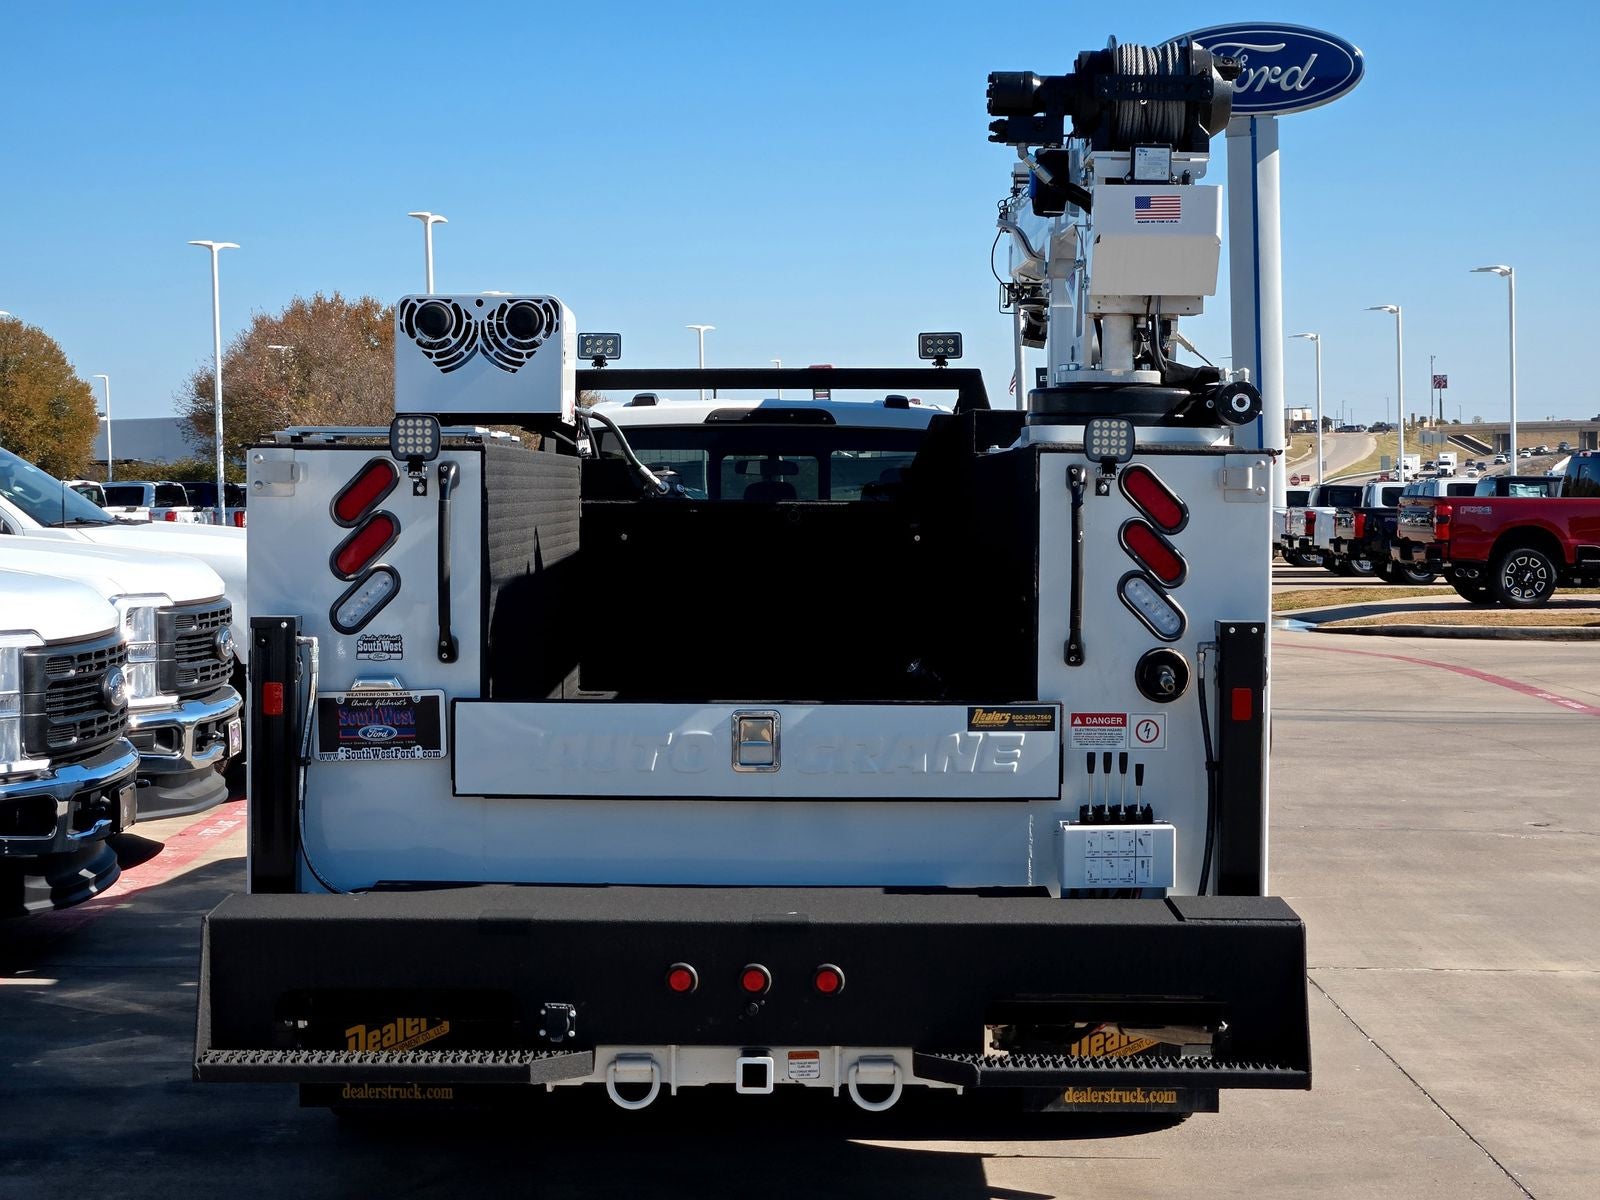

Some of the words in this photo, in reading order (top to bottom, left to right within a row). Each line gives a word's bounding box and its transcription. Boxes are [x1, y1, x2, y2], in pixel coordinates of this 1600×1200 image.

[338, 707, 416, 726] SouthWest
[971, 708, 1011, 724] Dealers
[1085, 716, 1123, 725] DANGER
[366, 727, 389, 738] Ford
[796, 731, 1026, 774] CRANE
[342, 1083, 454, 1099] dealerstruck.com
[1064, 1087, 1178, 1103] dealerstruck.com
